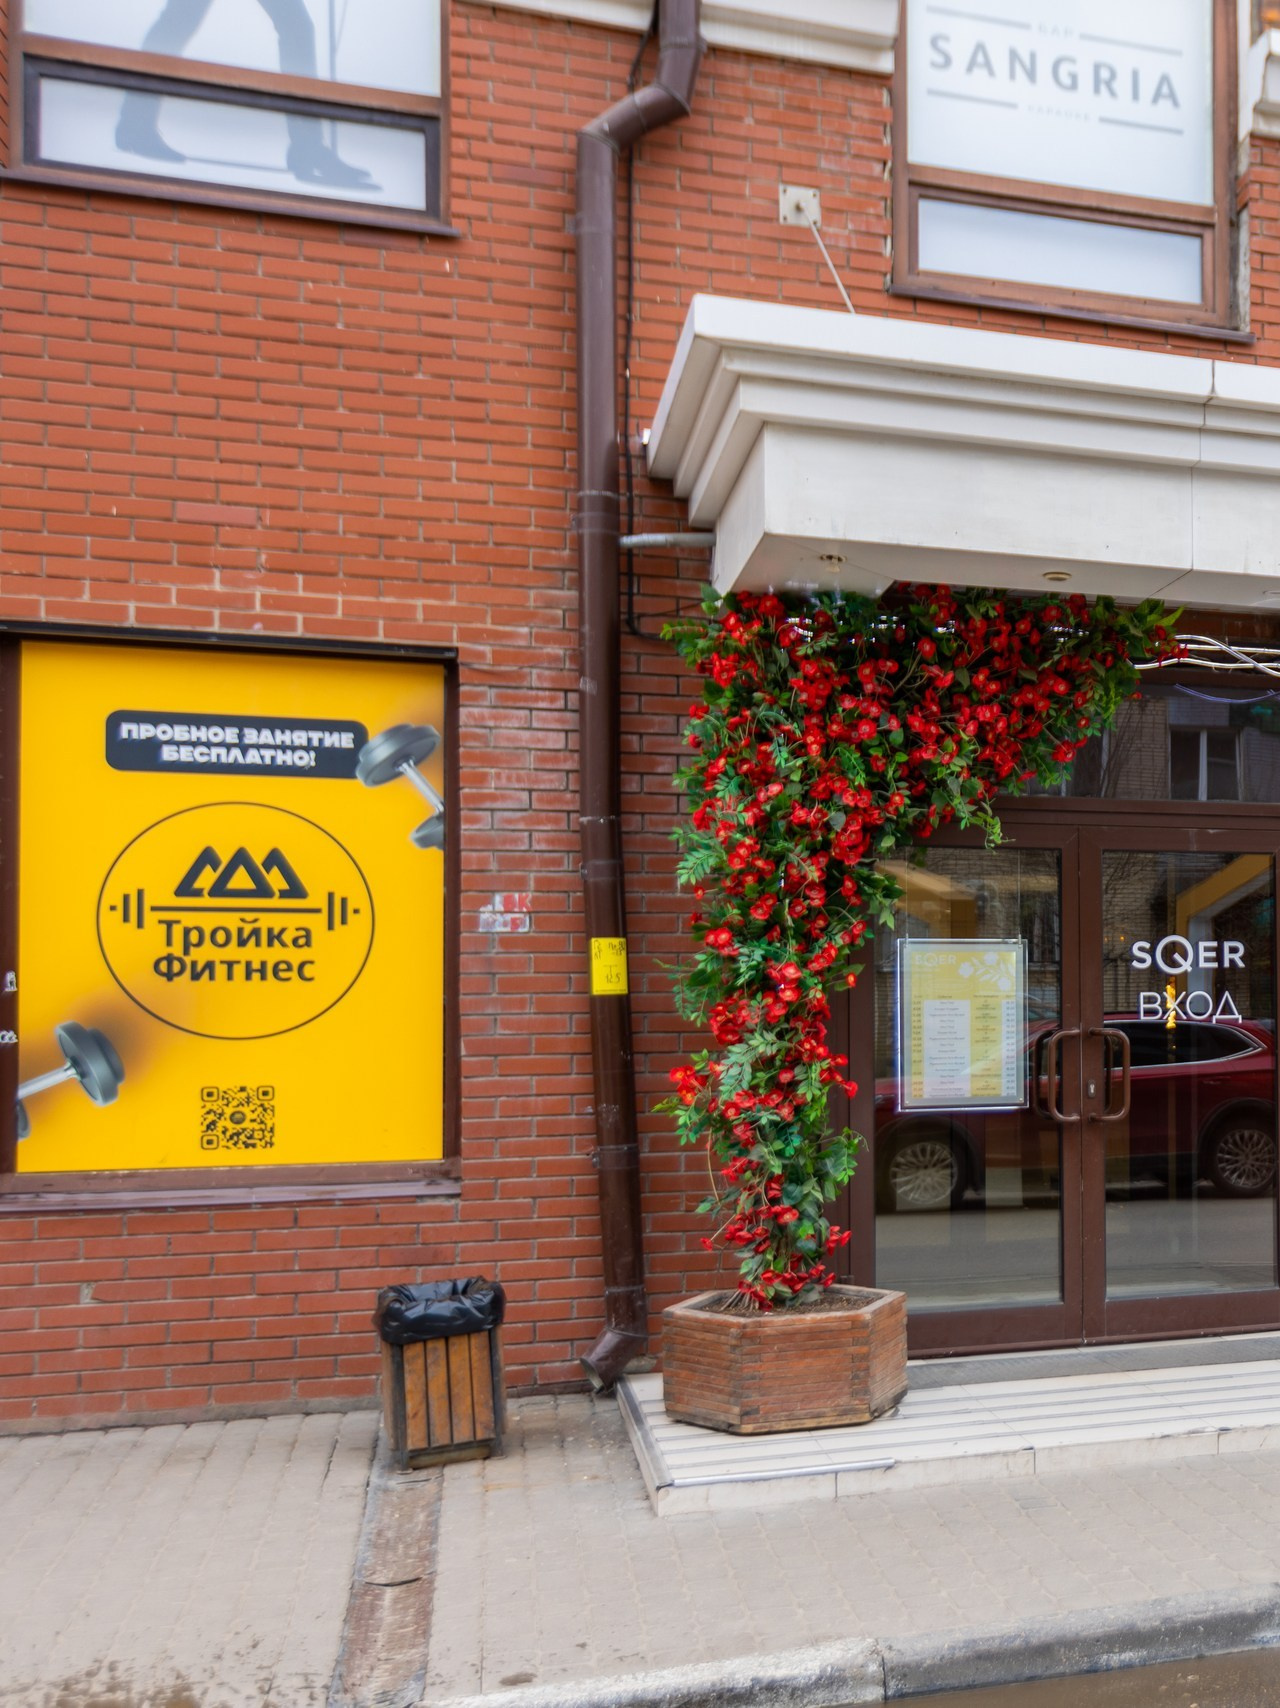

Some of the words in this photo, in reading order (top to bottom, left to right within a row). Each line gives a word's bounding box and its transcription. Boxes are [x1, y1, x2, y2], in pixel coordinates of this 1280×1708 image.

[929, 33, 1182, 109] SANGRIA
[121, 721, 239, 744] ПРОБНОЕ
[244, 727, 355, 749] ЗАНЯТИЕ
[161, 745, 317, 769] БЕСПЛАТНО!
[157, 918, 313, 957] Тройка
[1130, 934, 1247, 975] SQER
[152, 952, 317, 984] Фитнес
[1138, 990, 1243, 1024] ВХОД
